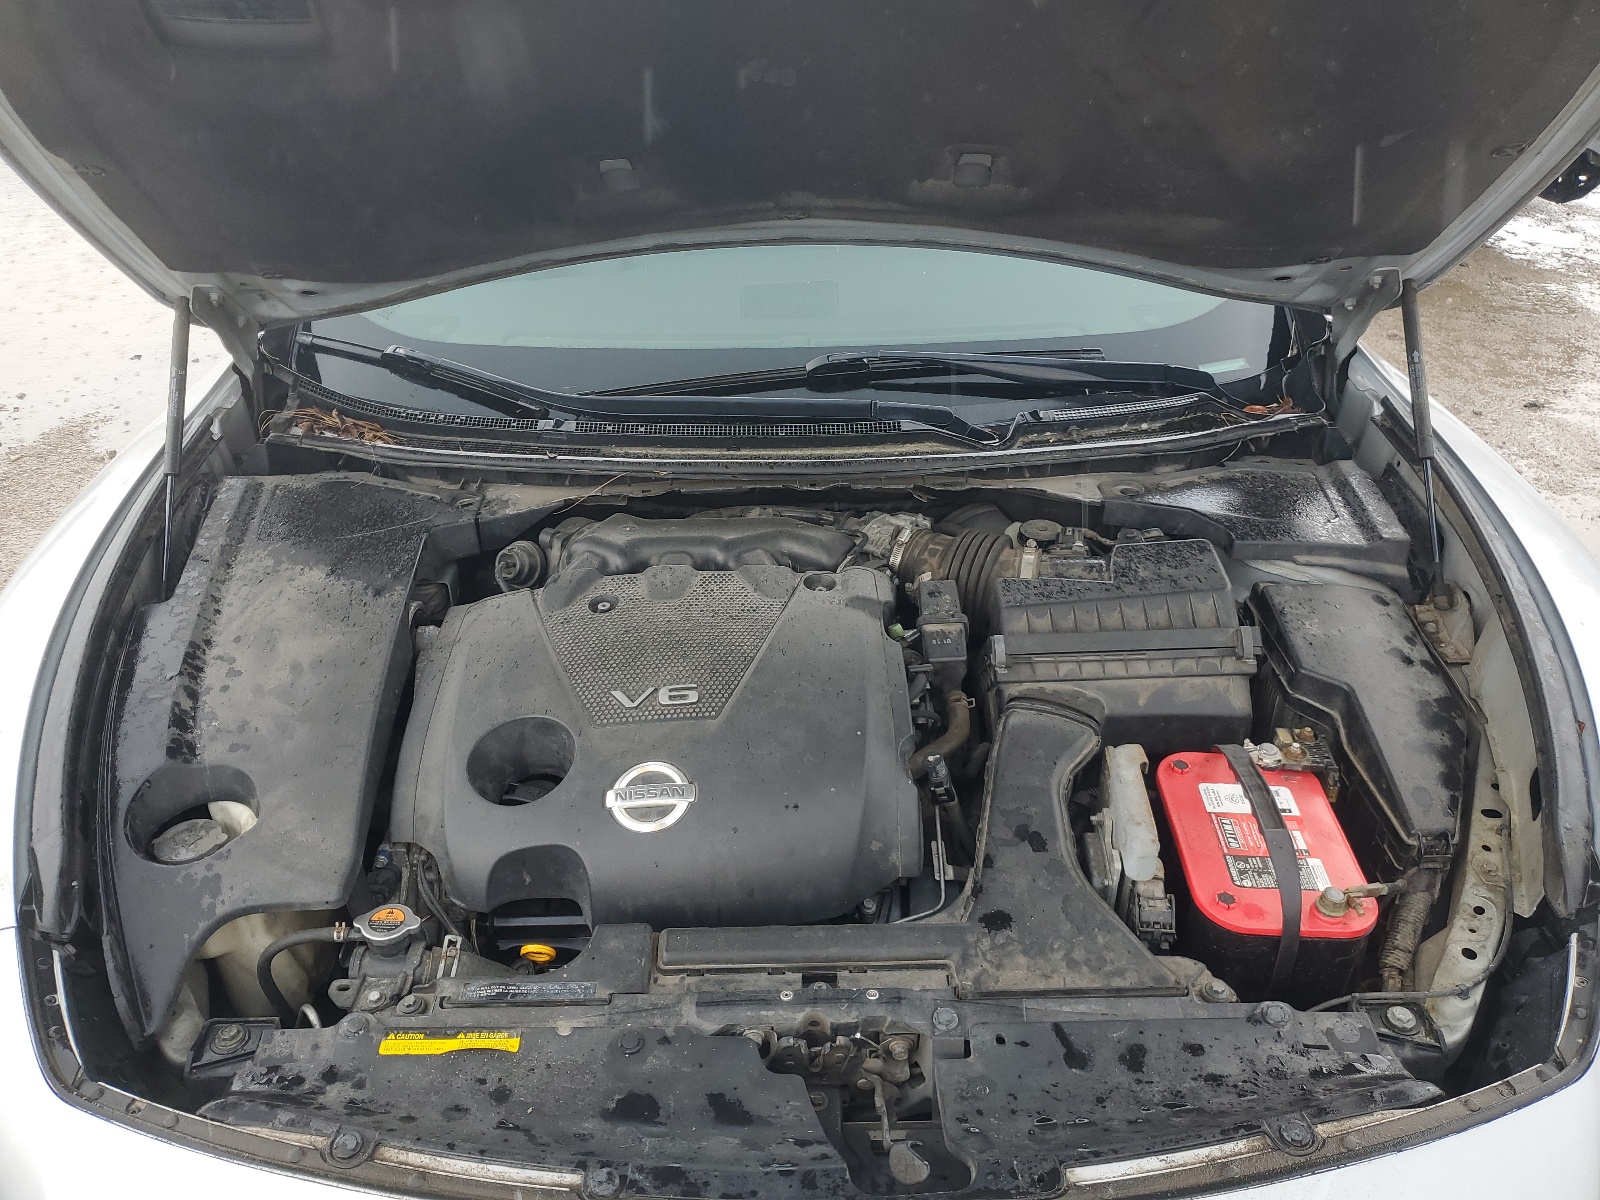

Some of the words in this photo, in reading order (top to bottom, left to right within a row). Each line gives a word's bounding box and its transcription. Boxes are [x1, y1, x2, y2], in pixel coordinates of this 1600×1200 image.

[611, 684, 699, 708] V6
[615, 786, 686, 802] NISSAN
[1219, 819, 1241, 849] OPTIMA
